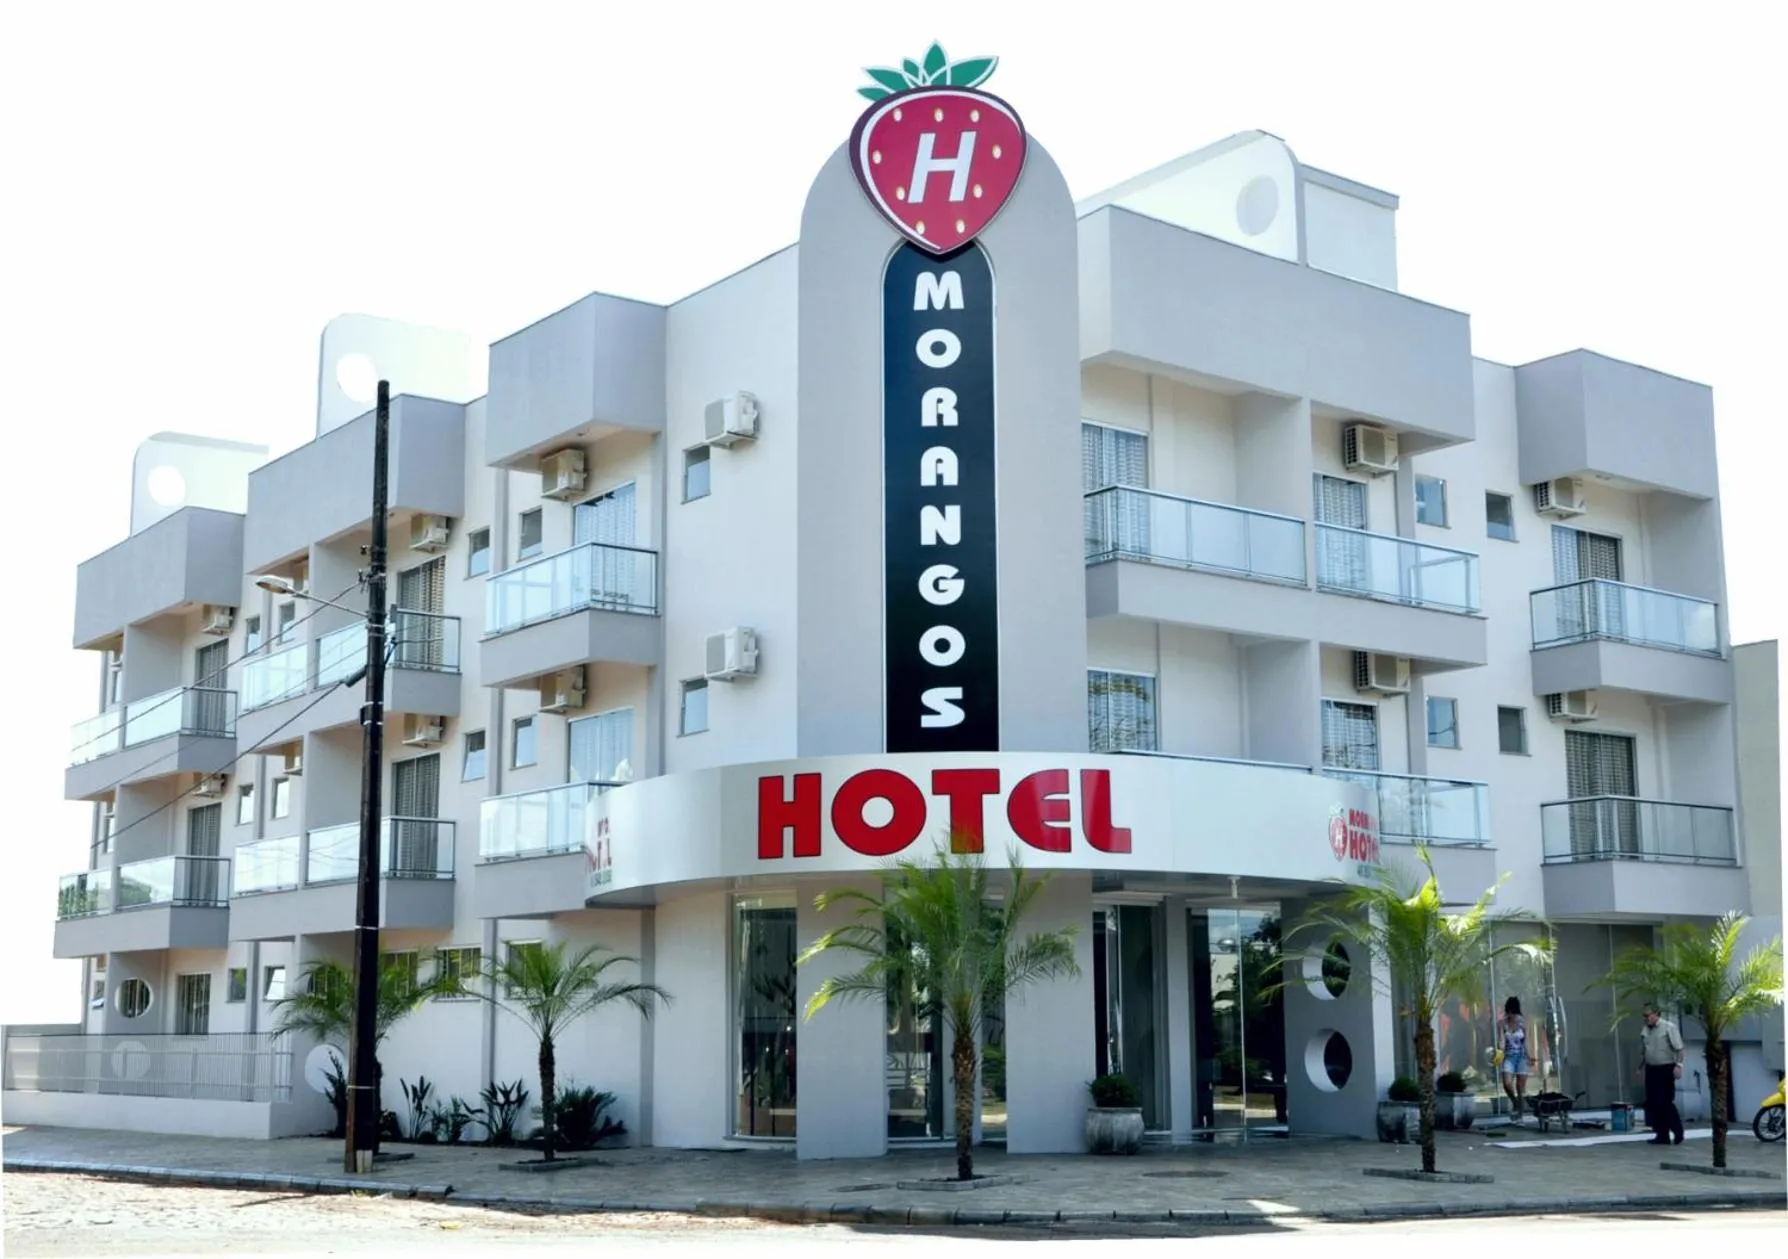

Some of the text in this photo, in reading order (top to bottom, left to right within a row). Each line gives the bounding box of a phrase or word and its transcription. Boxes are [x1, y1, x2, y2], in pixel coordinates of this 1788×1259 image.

[907, 131, 978, 204] H
[913, 270, 967, 729] MORANGOS
[758, 769, 1132, 859] HOTEL
